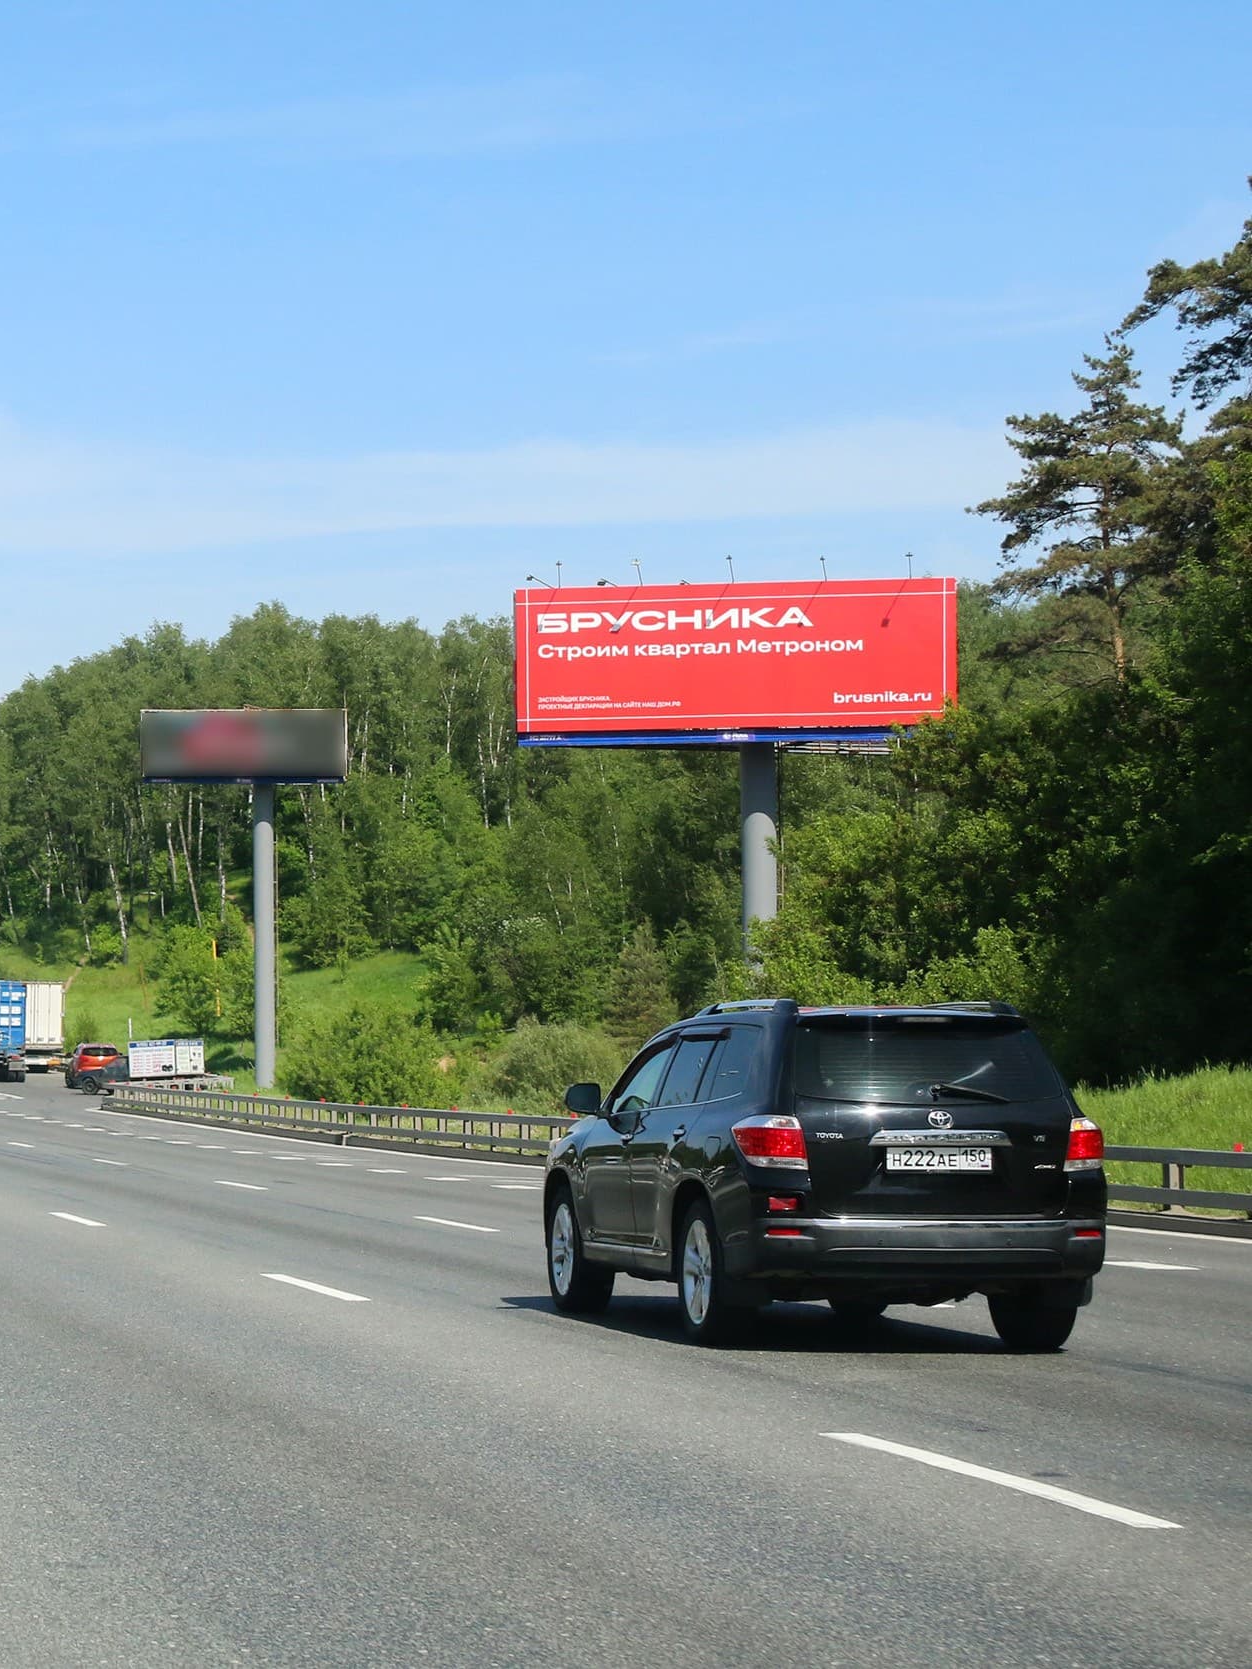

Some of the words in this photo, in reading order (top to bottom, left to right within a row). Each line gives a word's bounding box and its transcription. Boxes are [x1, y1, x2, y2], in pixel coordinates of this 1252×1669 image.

[536, 605, 815, 634] БРУСНИКА
[537, 643, 629, 662] Строим
[634, 642, 731, 659] квартал
[736, 638, 864, 657] Метроном
[833, 690, 932, 704] brusnika.ru
[816, 1132, 844, 1140] TOYOTA
[962, 1149, 986, 1162] 150
